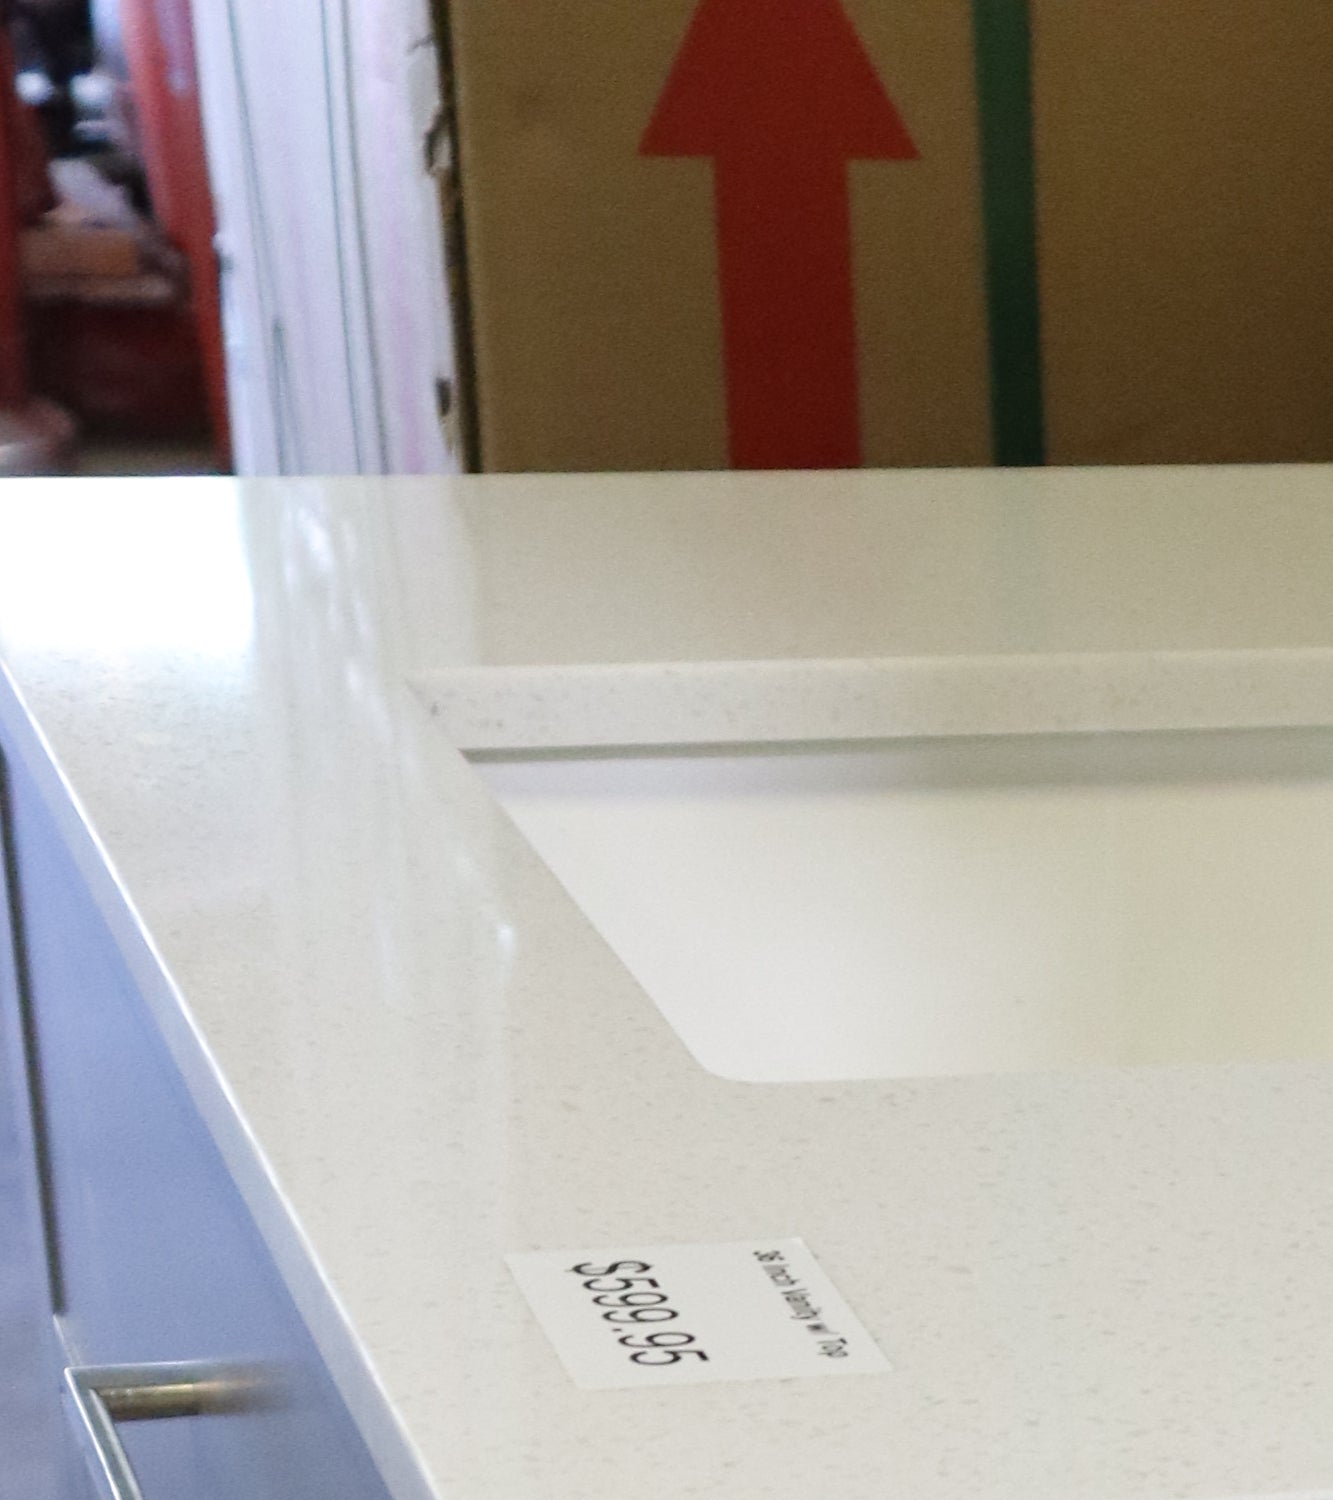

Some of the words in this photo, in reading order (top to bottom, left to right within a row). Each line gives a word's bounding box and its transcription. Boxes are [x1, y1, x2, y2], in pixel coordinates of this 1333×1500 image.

[565, 1260, 711, 1367] $599.95
[781, 1288, 822, 1320] Vanity
[817, 1338, 849, 1359] Top
